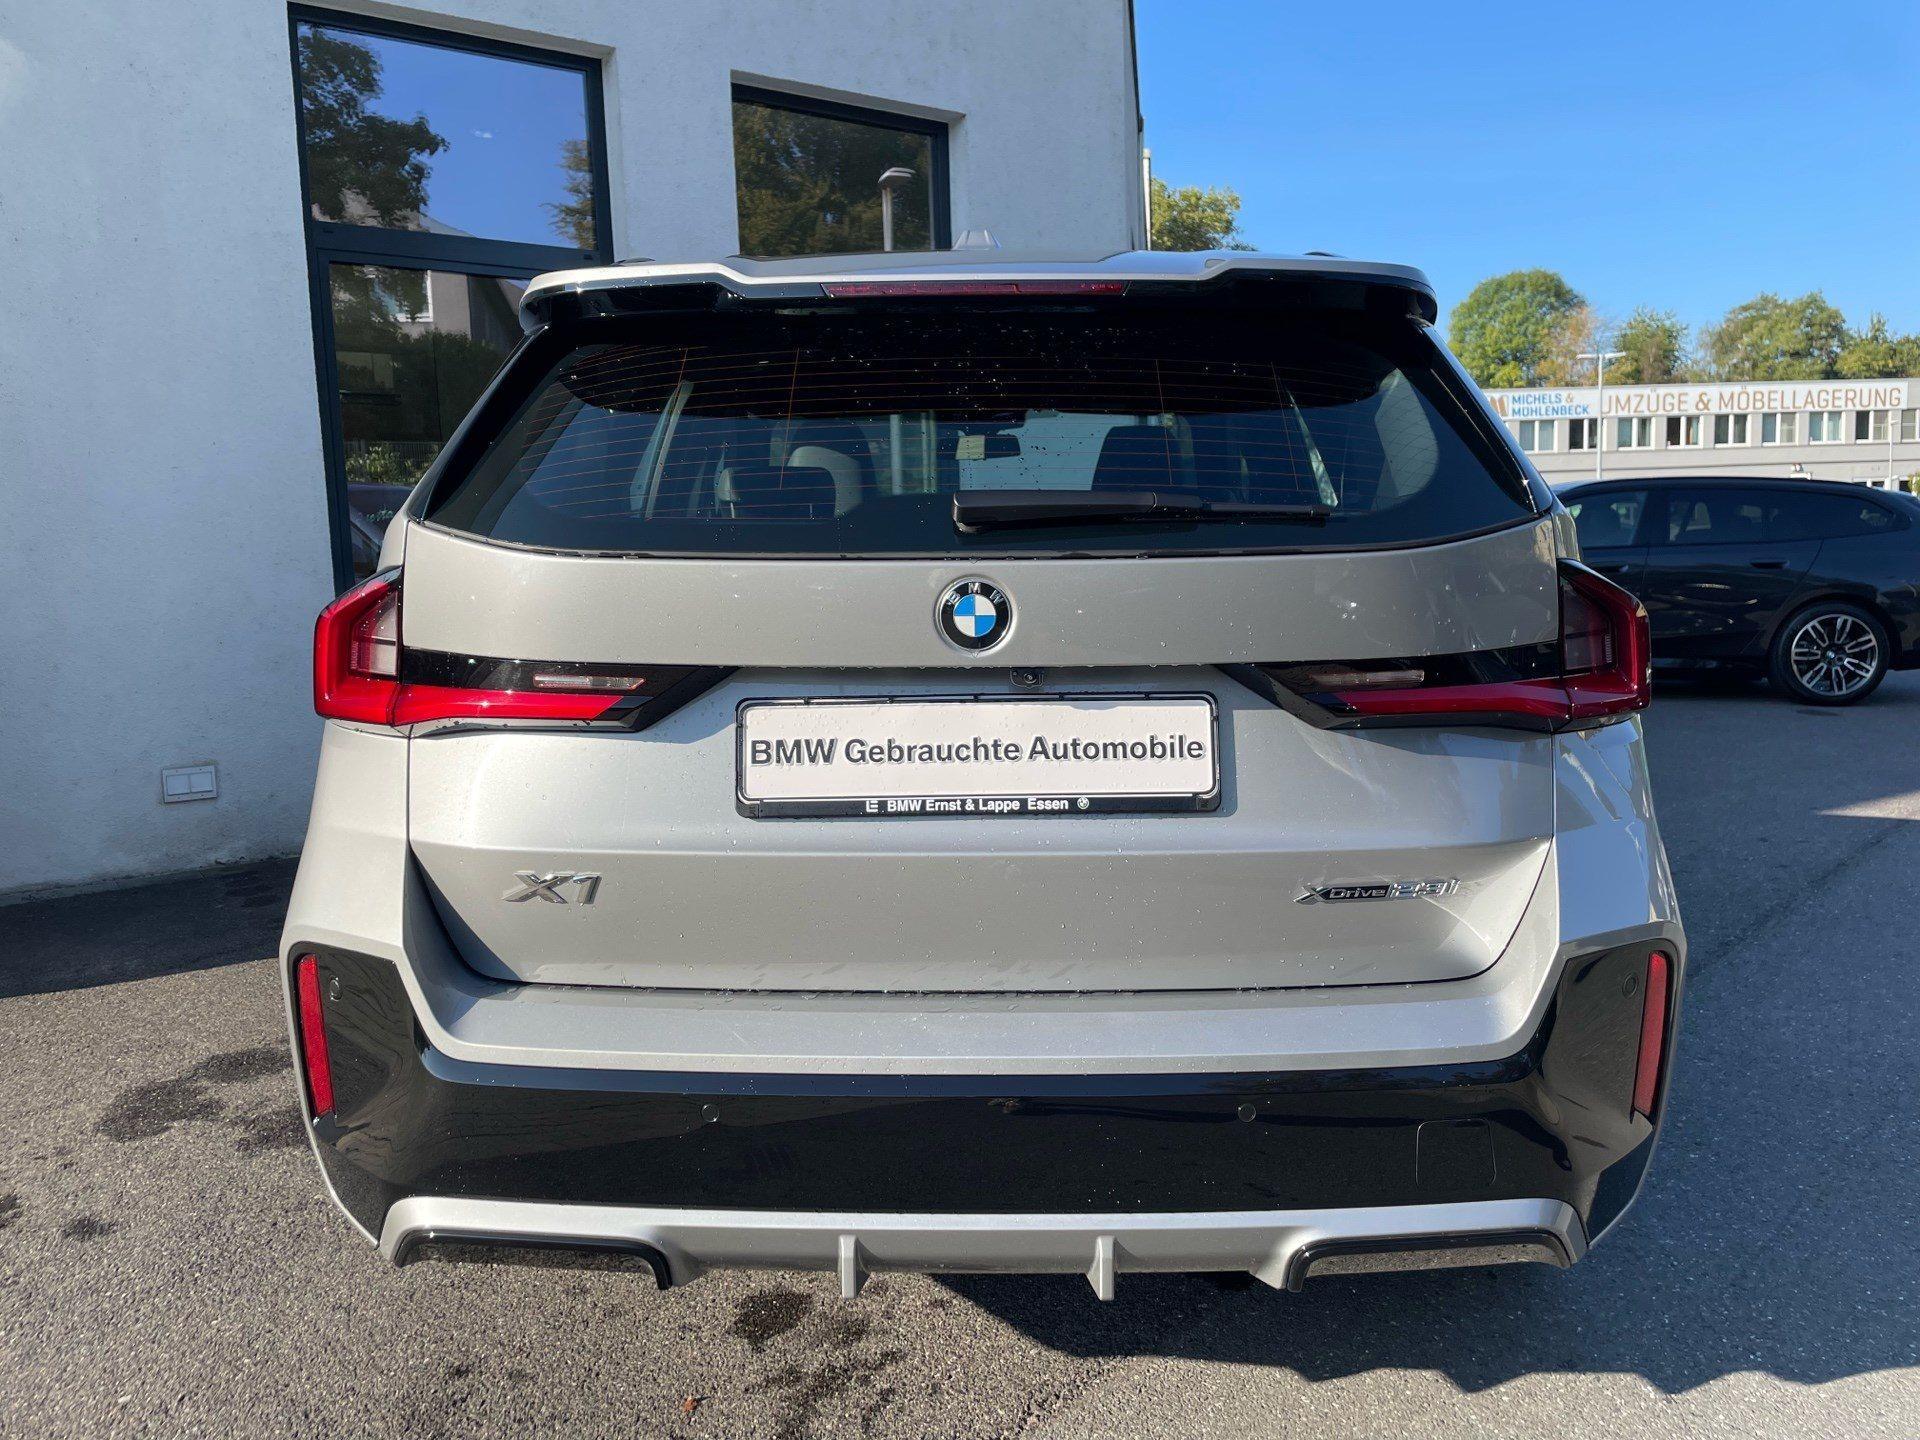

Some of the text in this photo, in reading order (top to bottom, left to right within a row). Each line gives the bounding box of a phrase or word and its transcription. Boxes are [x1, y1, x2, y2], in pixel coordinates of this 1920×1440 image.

[1512, 392, 1574, 405] MICHELS &
[1695, 391, 1712, 411] &
[1718, 385, 1902, 411] MÖBELLAGERUNG
[947, 582, 1004, 605] BMW
[750, 734, 1206, 766] BMW Gebrauchte Automobile
[887, 799, 922, 812] BMW
[926, 799, 962, 811] Ernst
[965, 799, 975, 811] &
[979, 798, 1020, 813] Lappe
[1027, 798, 1069, 810] Essen
[501, 871, 602, 904] X1
